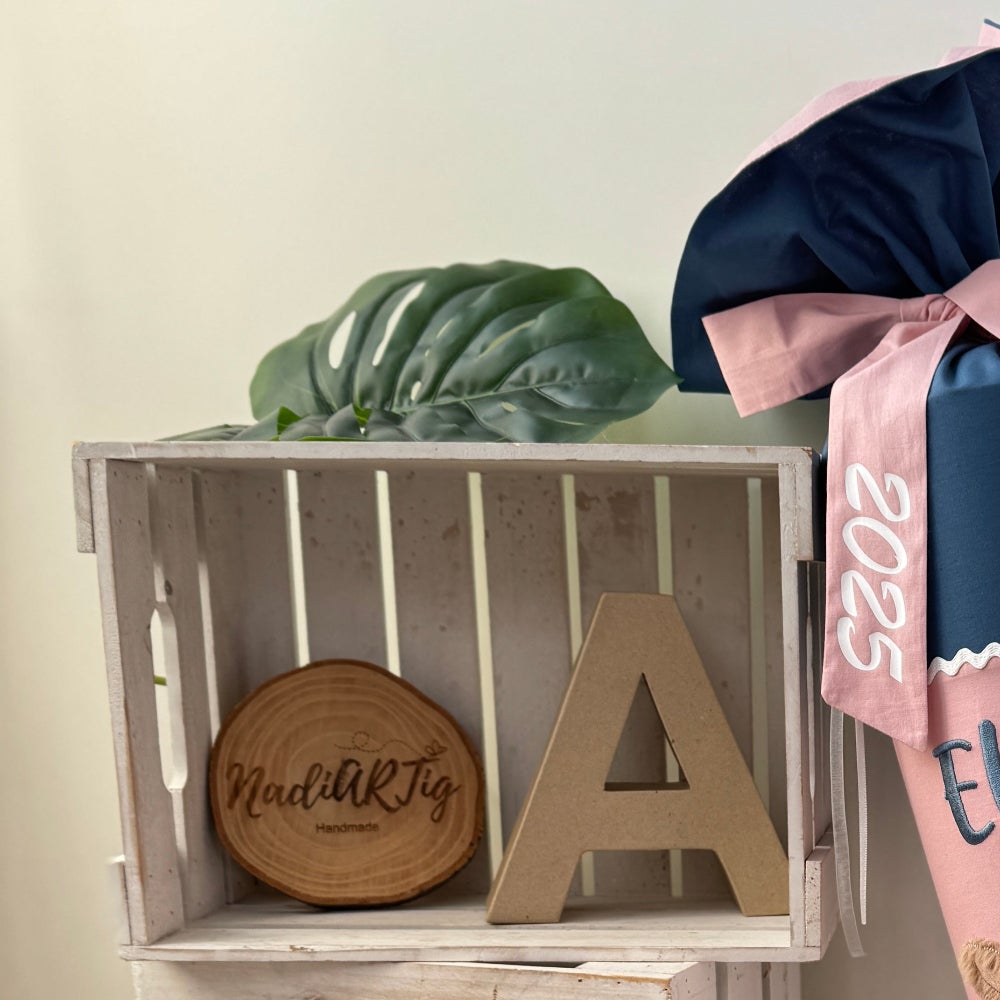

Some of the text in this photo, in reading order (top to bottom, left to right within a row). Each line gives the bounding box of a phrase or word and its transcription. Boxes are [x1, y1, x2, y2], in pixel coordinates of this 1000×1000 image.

[837, 462, 910, 684] 2025
[315, 822, 380, 834] Handmade
[486, 592, 790, 924] A
